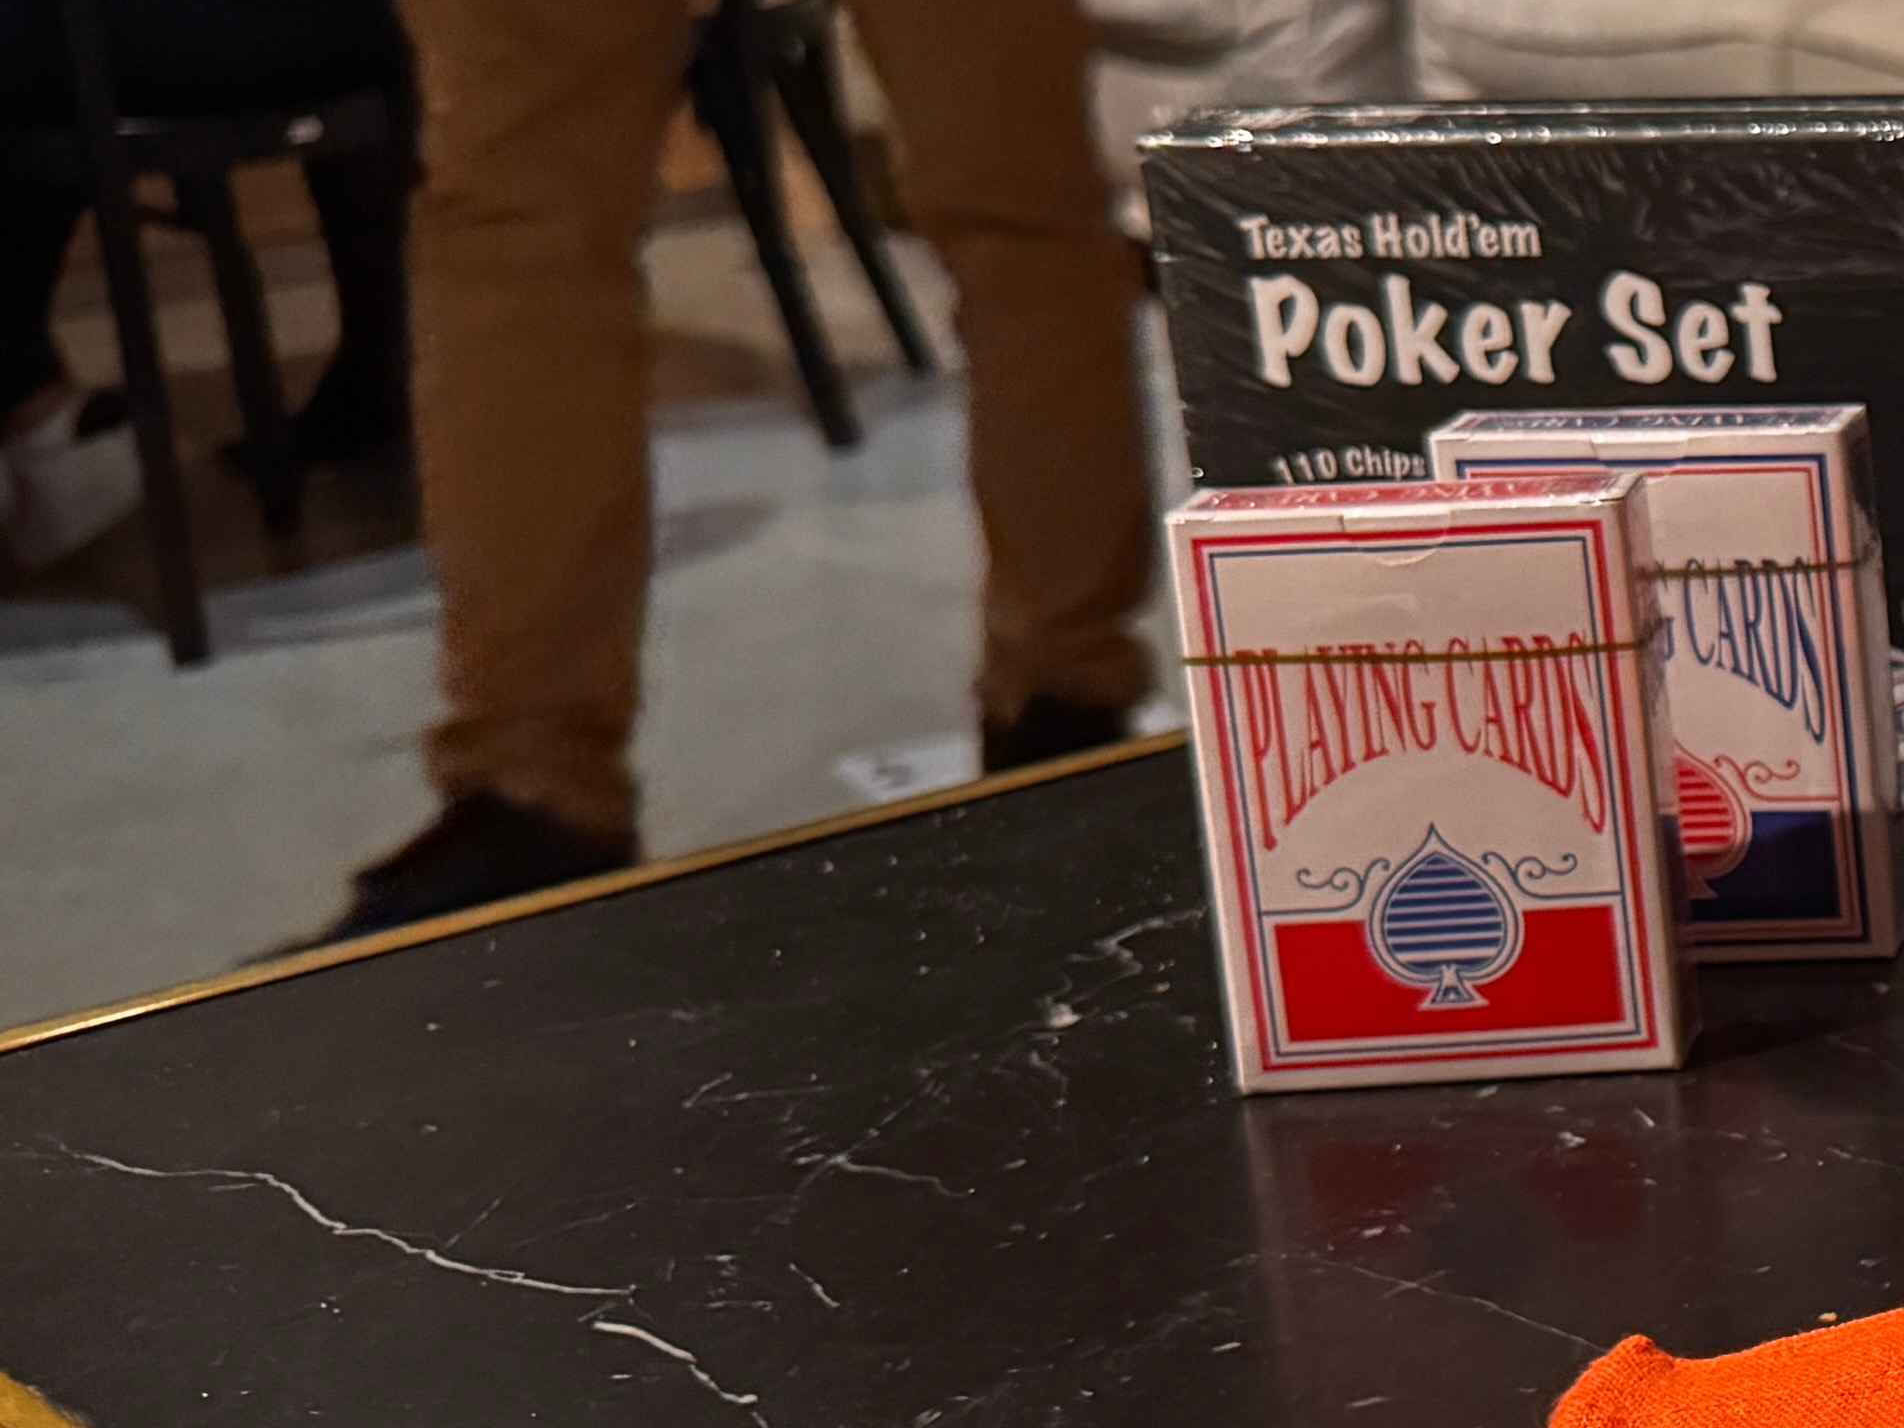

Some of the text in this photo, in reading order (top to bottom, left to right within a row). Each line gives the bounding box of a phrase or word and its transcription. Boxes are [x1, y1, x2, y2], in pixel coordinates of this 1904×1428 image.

[1241, 213, 1542, 260] Texas Hold'em
[1248, 271, 1783, 387] Poker Set
[1274, 445, 1426, 483] 110 Chips
[1683, 556, 1826, 746] CARDS
[1234, 628, 1606, 851] PLAYING CARDS
